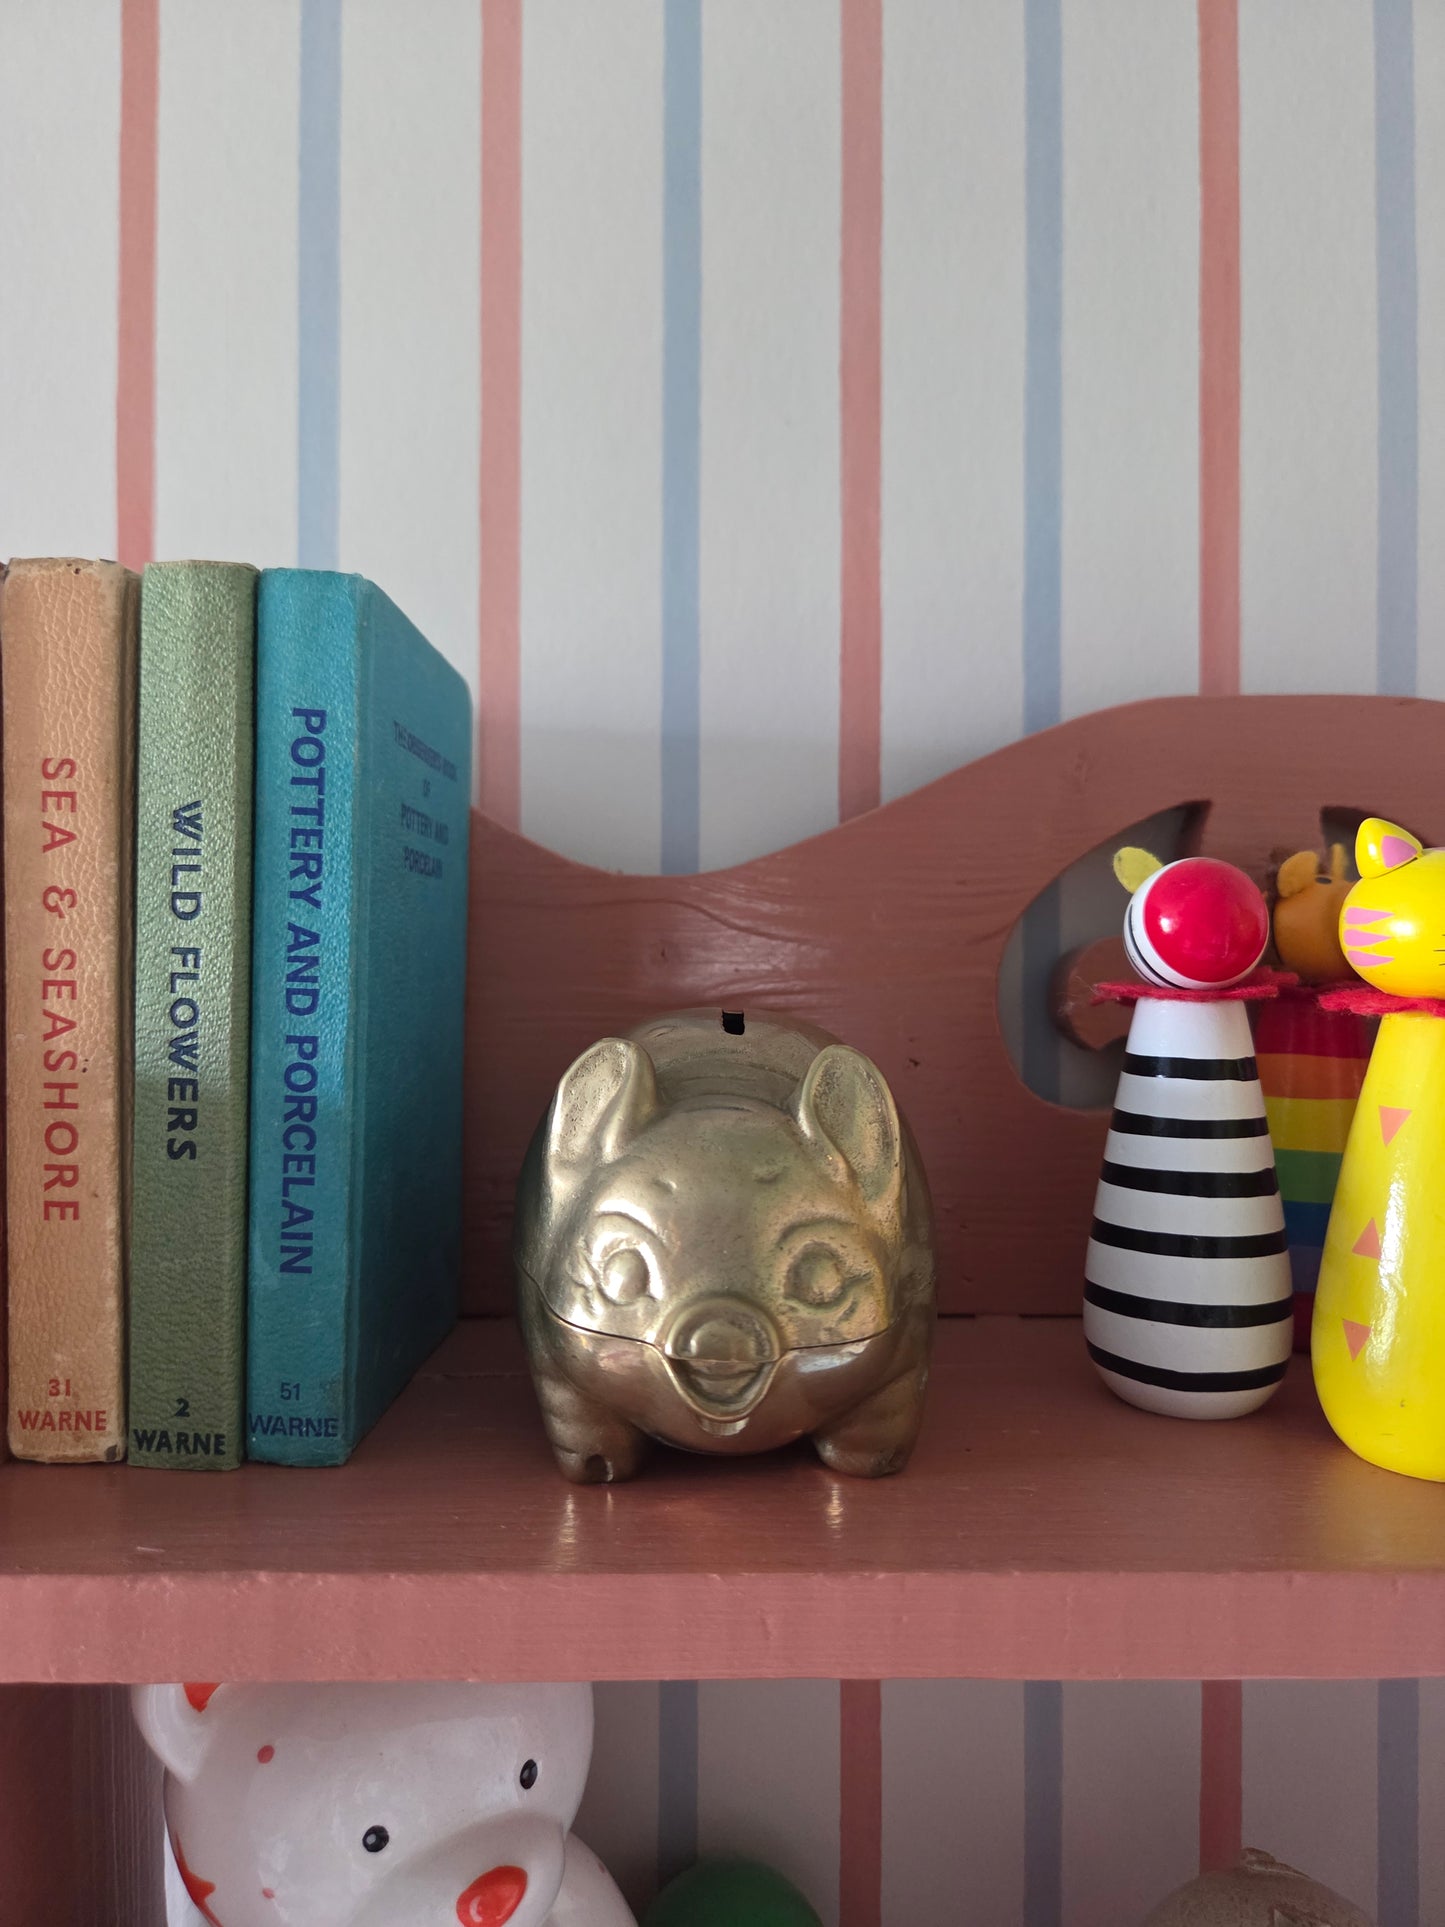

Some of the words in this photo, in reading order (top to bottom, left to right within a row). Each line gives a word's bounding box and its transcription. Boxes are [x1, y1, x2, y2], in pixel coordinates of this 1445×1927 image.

[41, 757, 77, 853] SEA
[287, 708, 327, 910] POTTERY
[171, 800, 204, 920] WILD
[42, 885, 78, 938] &
[285, 922, 321, 1017] AND
[42, 948, 80, 1222] SEASHORE
[166, 947, 202, 1161] FLOWERS
[279, 1035, 319, 1274] PORCELAIN
[18, 1410, 107, 1431] WARNE
[48, 1379, 71, 1397] 31
[174, 1398, 191, 1417] 2
[249, 1413, 339, 1437] WARNE
[280, 1382, 300, 1400] 51
[134, 1429, 226, 1456] WARNE
